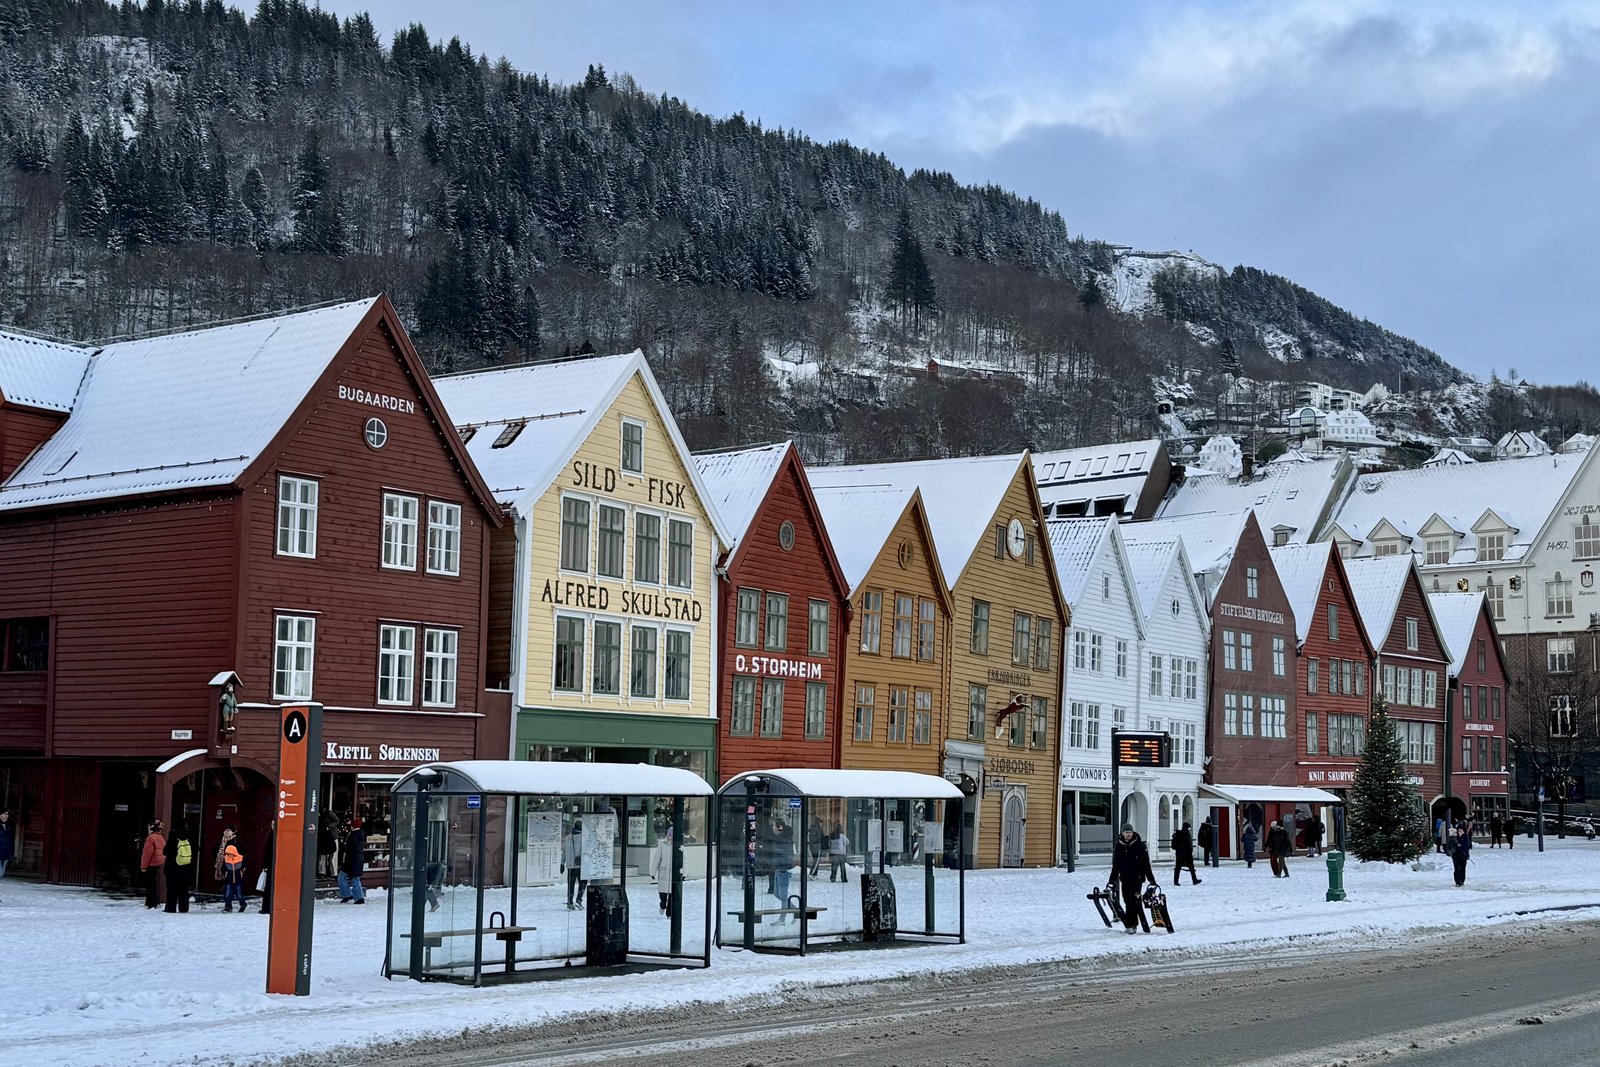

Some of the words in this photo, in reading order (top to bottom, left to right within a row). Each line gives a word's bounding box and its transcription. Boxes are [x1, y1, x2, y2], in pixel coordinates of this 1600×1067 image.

[338, 385, 415, 414] BUGAARDEN
[573, 460, 616, 493] SILD
[648, 477, 686, 509] FISK
[541, 578, 609, 611] ALFRED
[621, 590, 702, 622] SKULSTAD
[1220, 602, 1257, 620] STIFTELSEN
[1257, 609, 1285, 625] BRYGGEN
[289, 718, 301, 737] A
[326, 742, 371, 760] KJETIL
[379, 744, 440, 761] SØRENSEN
[990, 758, 1034, 775] SJØBODEN
[1070, 767, 1107, 781] O'CONNOR'S
[1308, 771, 1325, 781] KNUT
